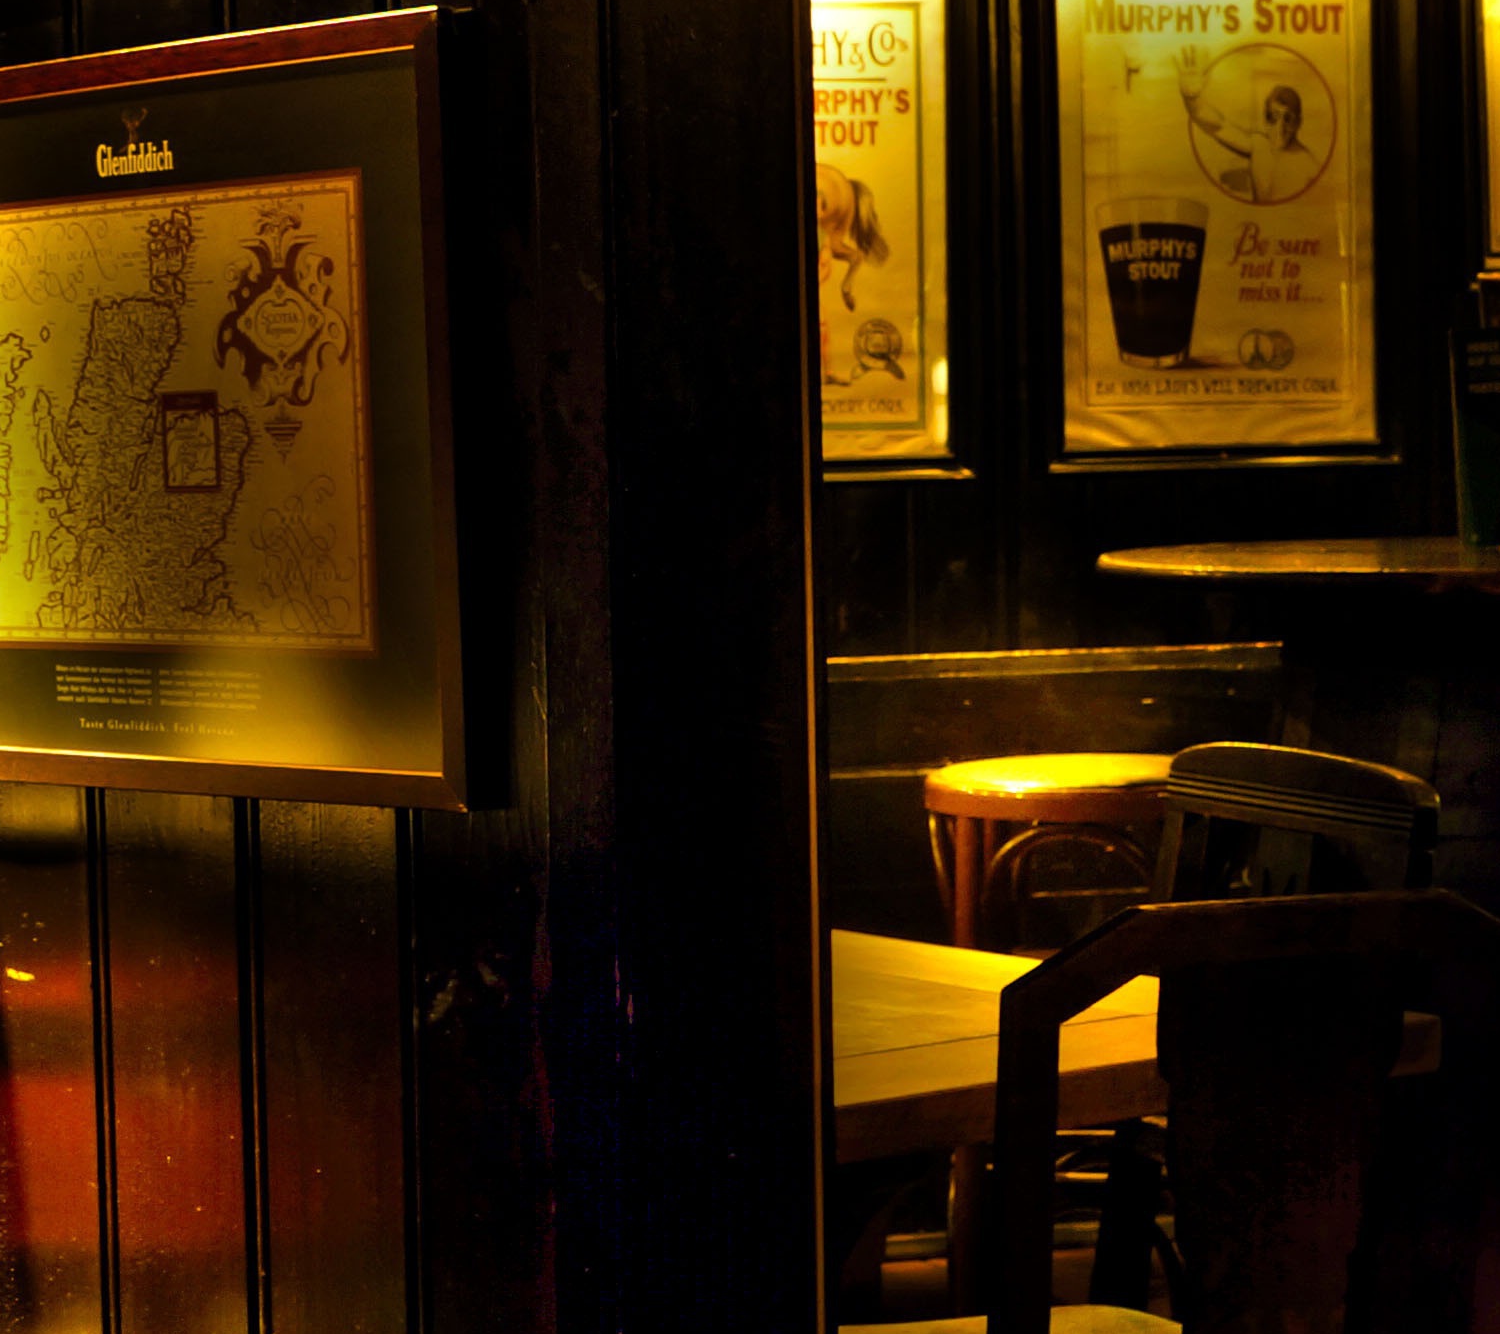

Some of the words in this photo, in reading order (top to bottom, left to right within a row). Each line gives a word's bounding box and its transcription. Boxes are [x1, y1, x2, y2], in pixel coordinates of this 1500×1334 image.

[95, 139, 175, 178] Glenfiddich
[1107, 238, 1198, 262] MURPHYS
[1128, 262, 1182, 282] STOUT
